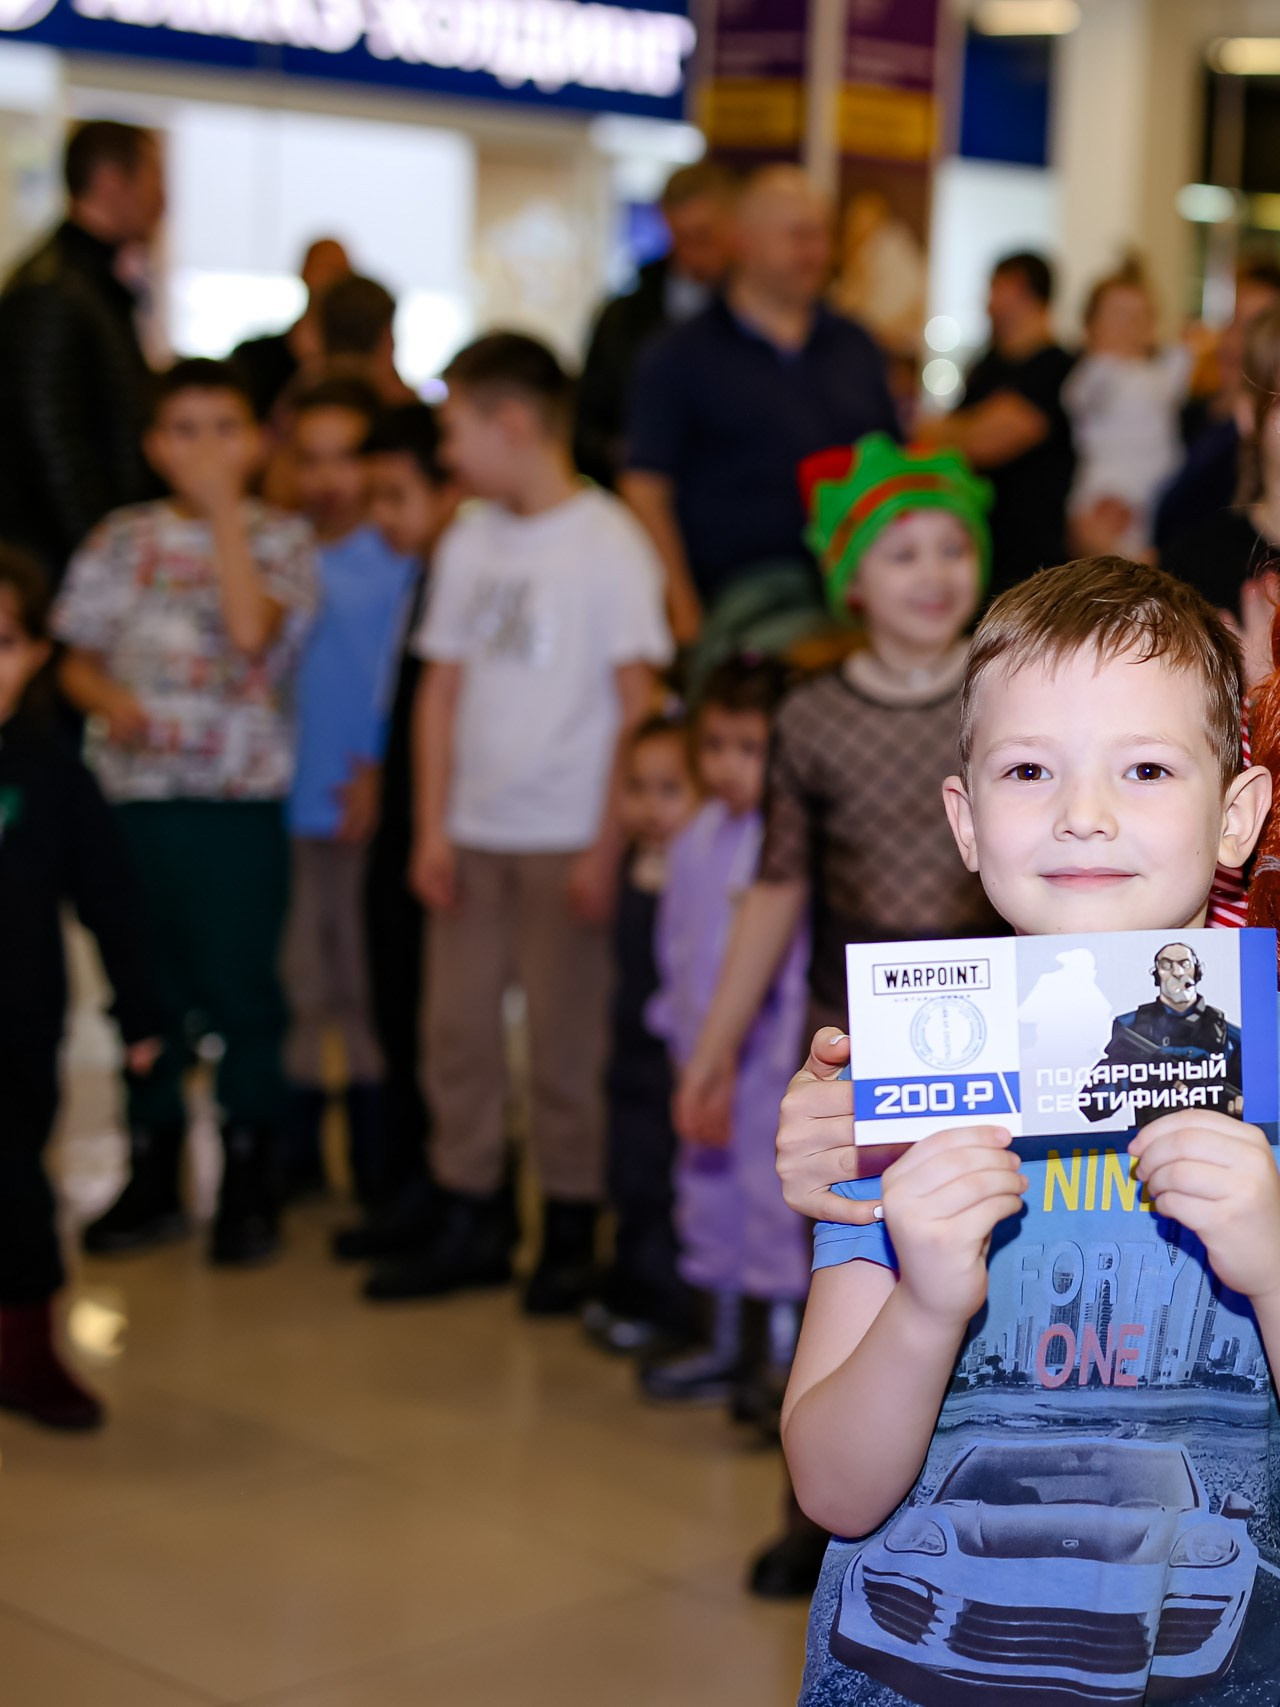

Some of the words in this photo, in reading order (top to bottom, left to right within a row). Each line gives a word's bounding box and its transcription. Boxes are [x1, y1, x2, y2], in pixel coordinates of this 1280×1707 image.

[1038, 1053, 1227, 1087] ПОДАРОЧНЫЙ
[873, 1083, 955, 1115] 200
[1039, 1086, 1225, 1113] СЕРТИФИКАТ
[1013, 1240, 1193, 1306] FORTY
[1036, 1322, 1145, 1388] ONE
